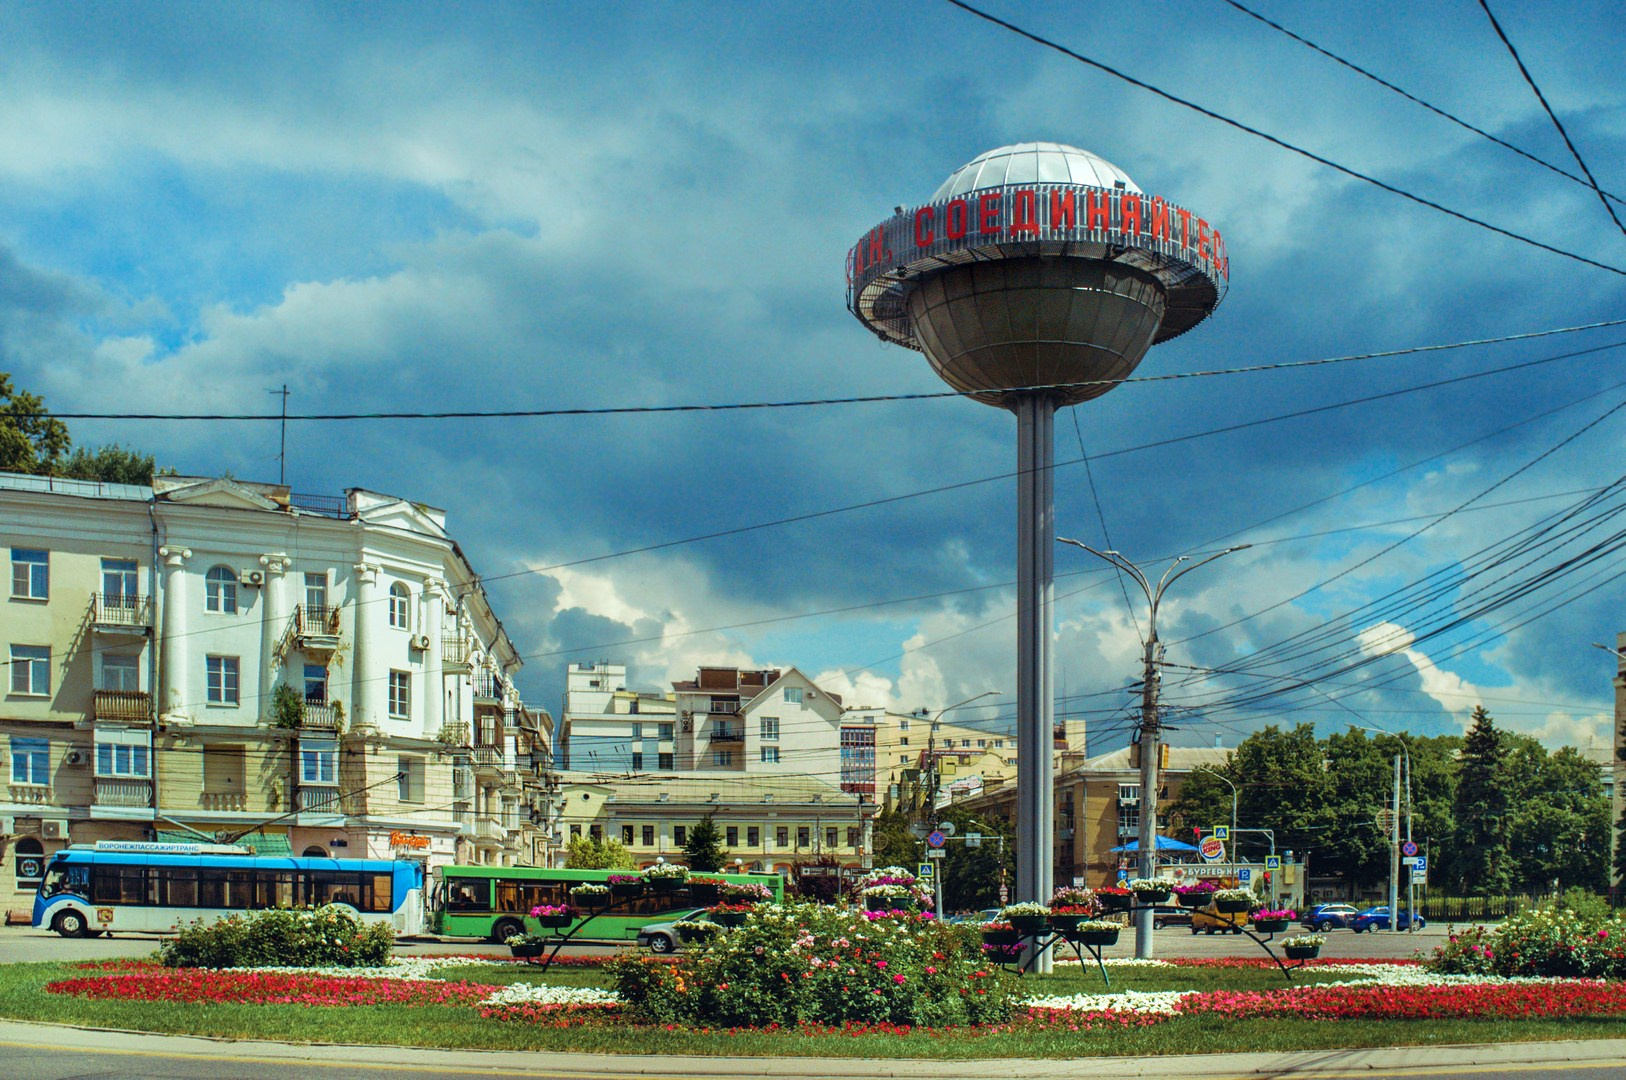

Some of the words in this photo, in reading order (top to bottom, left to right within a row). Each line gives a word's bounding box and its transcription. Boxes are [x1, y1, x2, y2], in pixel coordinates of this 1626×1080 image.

[98, 842, 199, 852] ВОРОНЕЖПАССАЖИРТРАНС
[1203, 844, 1221, 853] KING
[1188, 868, 1223, 876] БУРГЕР
